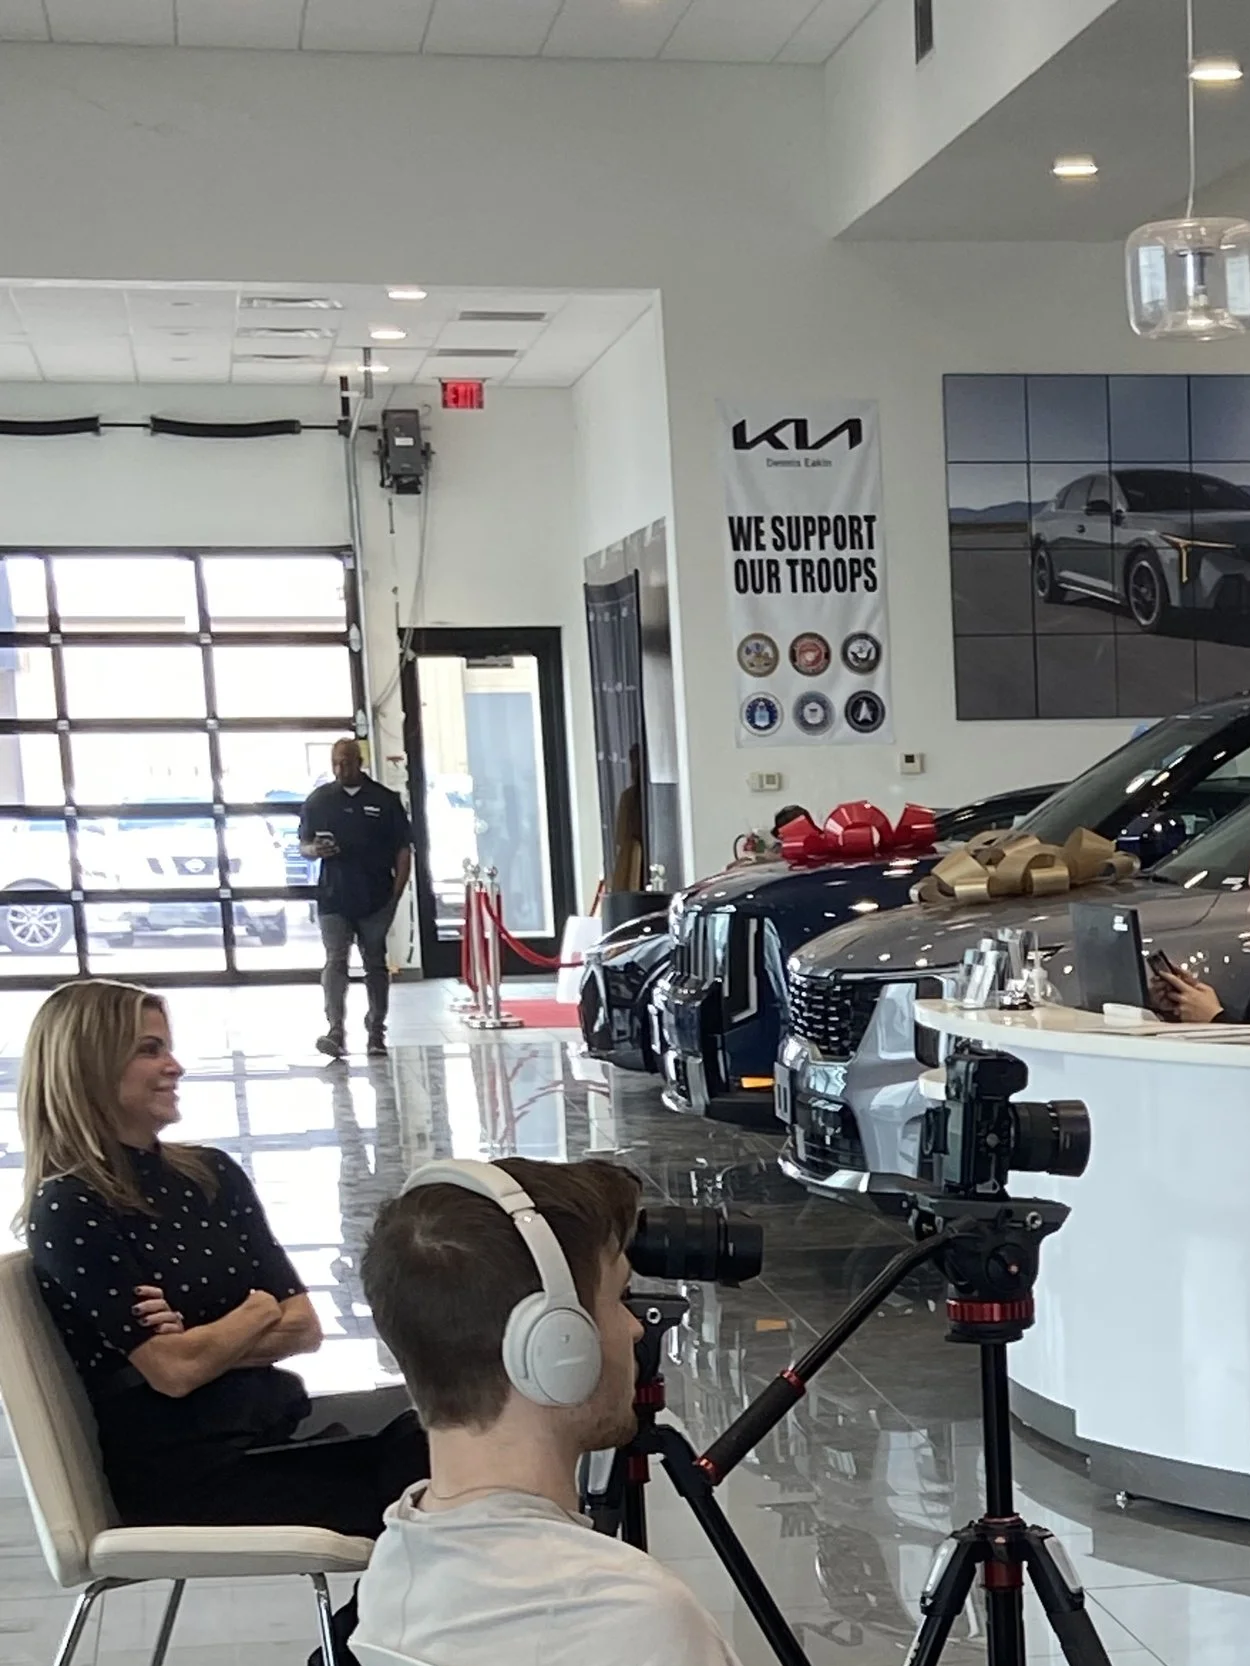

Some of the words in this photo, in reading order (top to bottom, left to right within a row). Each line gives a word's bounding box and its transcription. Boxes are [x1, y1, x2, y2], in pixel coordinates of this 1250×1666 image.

[732, 418, 863, 450] KIA
[728, 516, 766, 551] WE
[771, 514, 876, 551] SUPPORT
[734, 558, 781, 594] OUR
[786, 557, 878, 593] TROOPS
